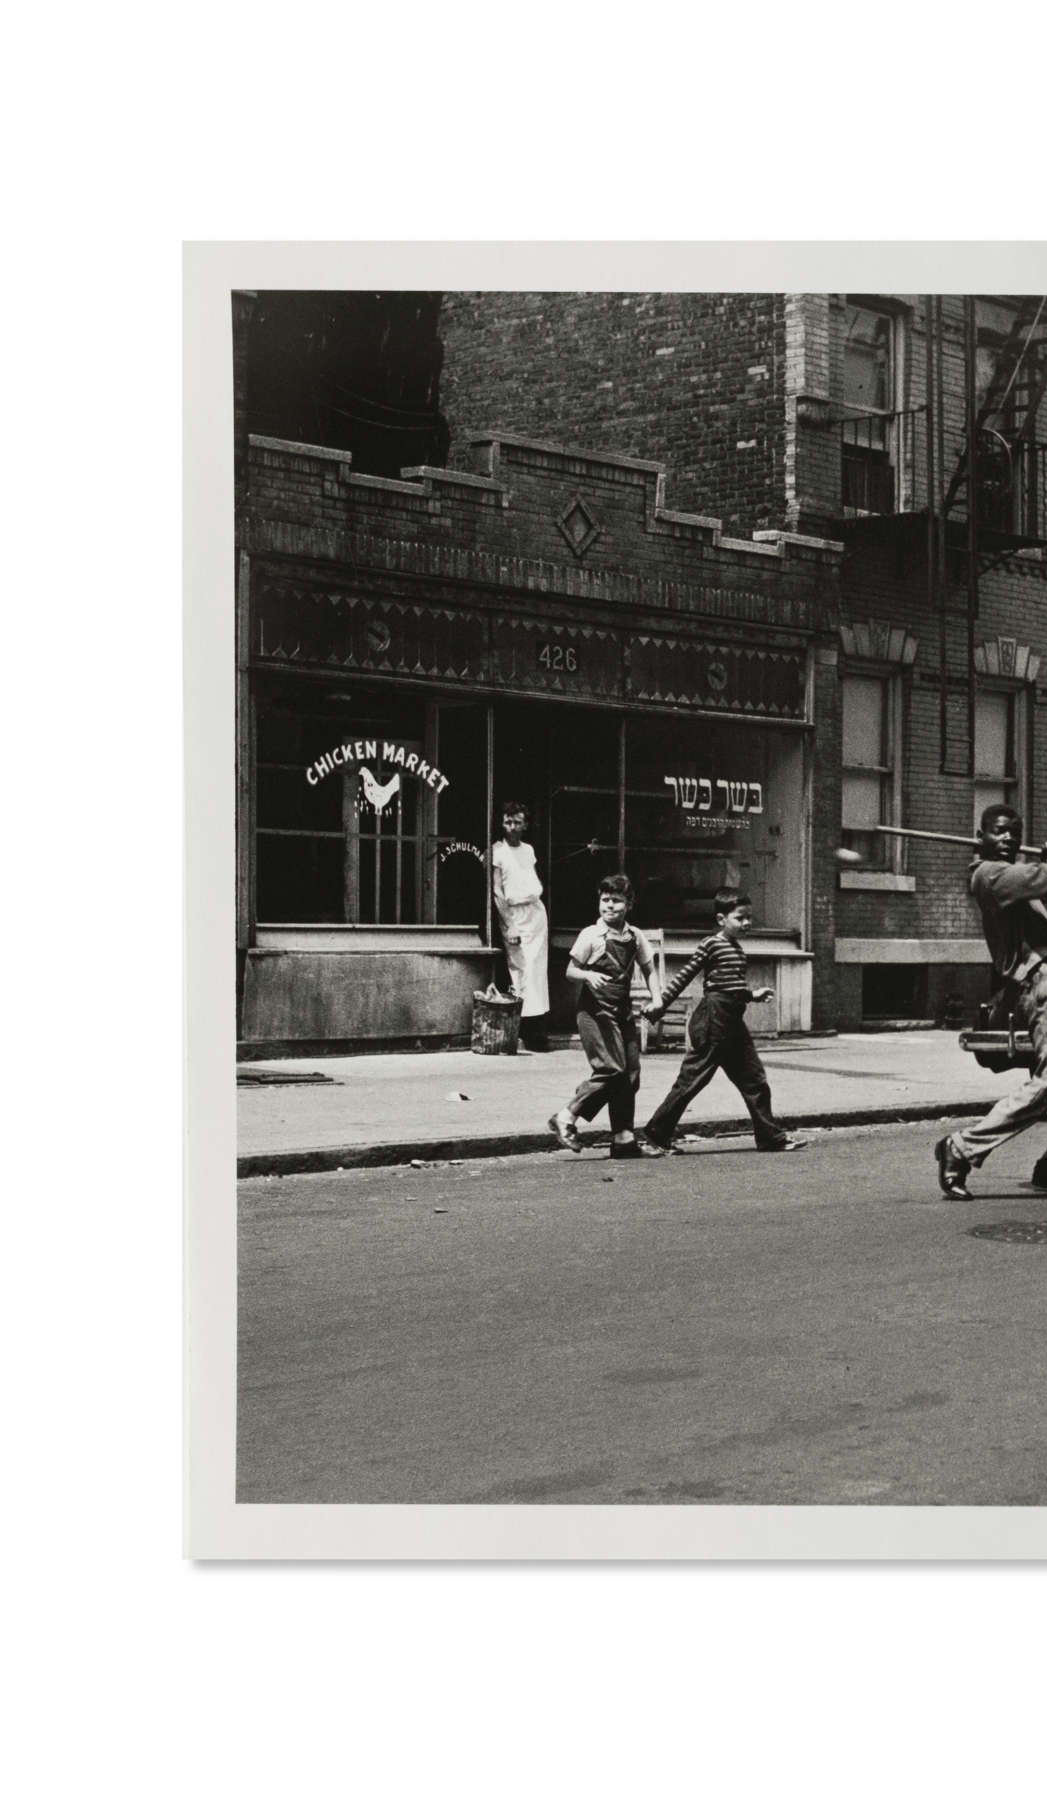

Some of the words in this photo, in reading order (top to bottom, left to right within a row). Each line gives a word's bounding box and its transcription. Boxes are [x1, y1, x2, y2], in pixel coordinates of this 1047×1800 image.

[539, 644, 577, 672] 426
[306, 740, 377, 786] CHICKEN
[382, 741, 450, 794] MARKET
